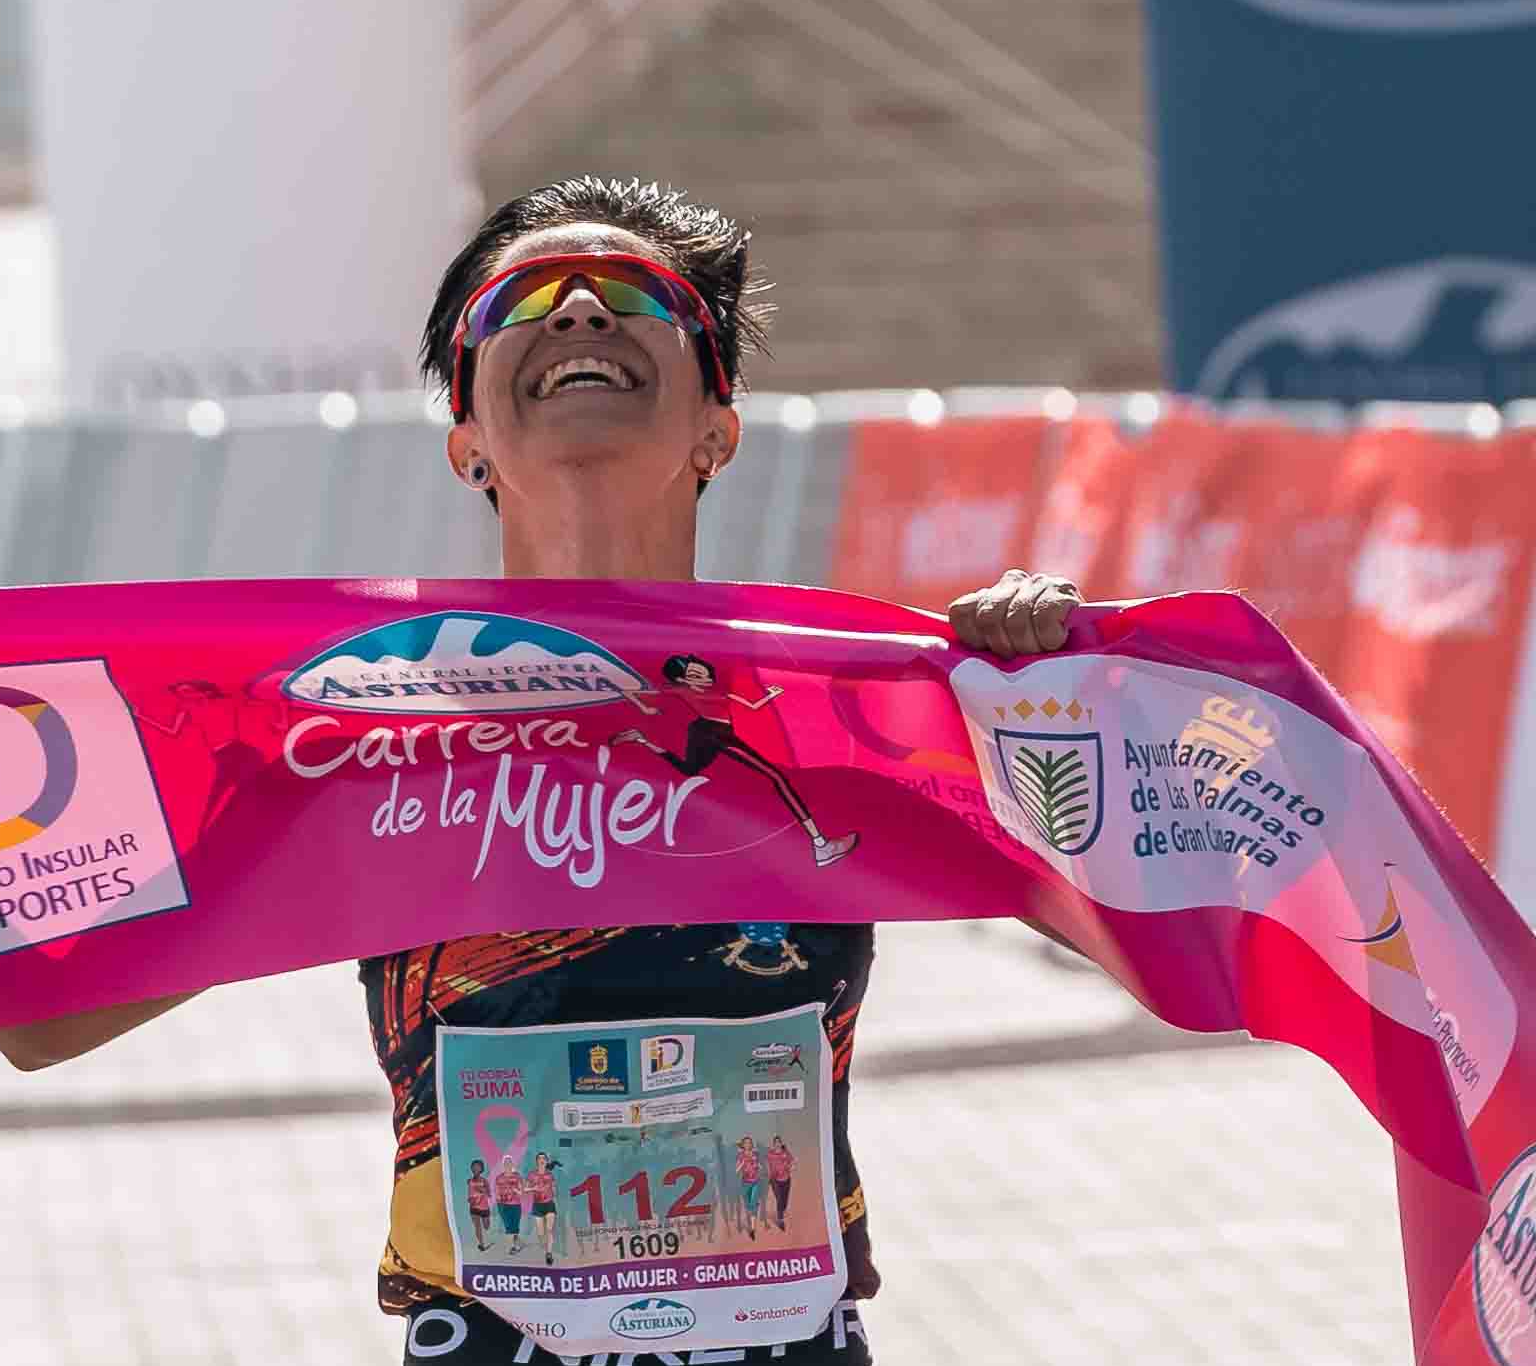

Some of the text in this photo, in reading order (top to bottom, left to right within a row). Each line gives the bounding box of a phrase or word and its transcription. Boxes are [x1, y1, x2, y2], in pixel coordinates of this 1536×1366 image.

[320, 675, 624, 699] ASTURIANA
[360, 663, 602, 684] CENTRAL LECHERA
[284, 714, 591, 778] Carrera
[1122, 738, 1326, 829] Ayuntamiento
[371, 745, 709, 888] de la Mujer
[1131, 779, 1160, 813] de
[1194, 779, 1302, 850] Palmas
[20, 832, 139, 881] INSULAR
[1133, 824, 1167, 858] de
[1170, 823, 1207, 854] Gran
[1439, 1020, 1481, 1091] Promoción
[462, 1082, 524, 1099] SUMA
[569, 1166, 711, 1224] 112
[614, 1232, 680, 1259] 1609
[472, 1256, 822, 1293] CARRERA DE LA MUJER GRAN CANARIA
[614, 1315, 691, 1332] ASTURIANA
[749, 1304, 809, 1321] Santander
